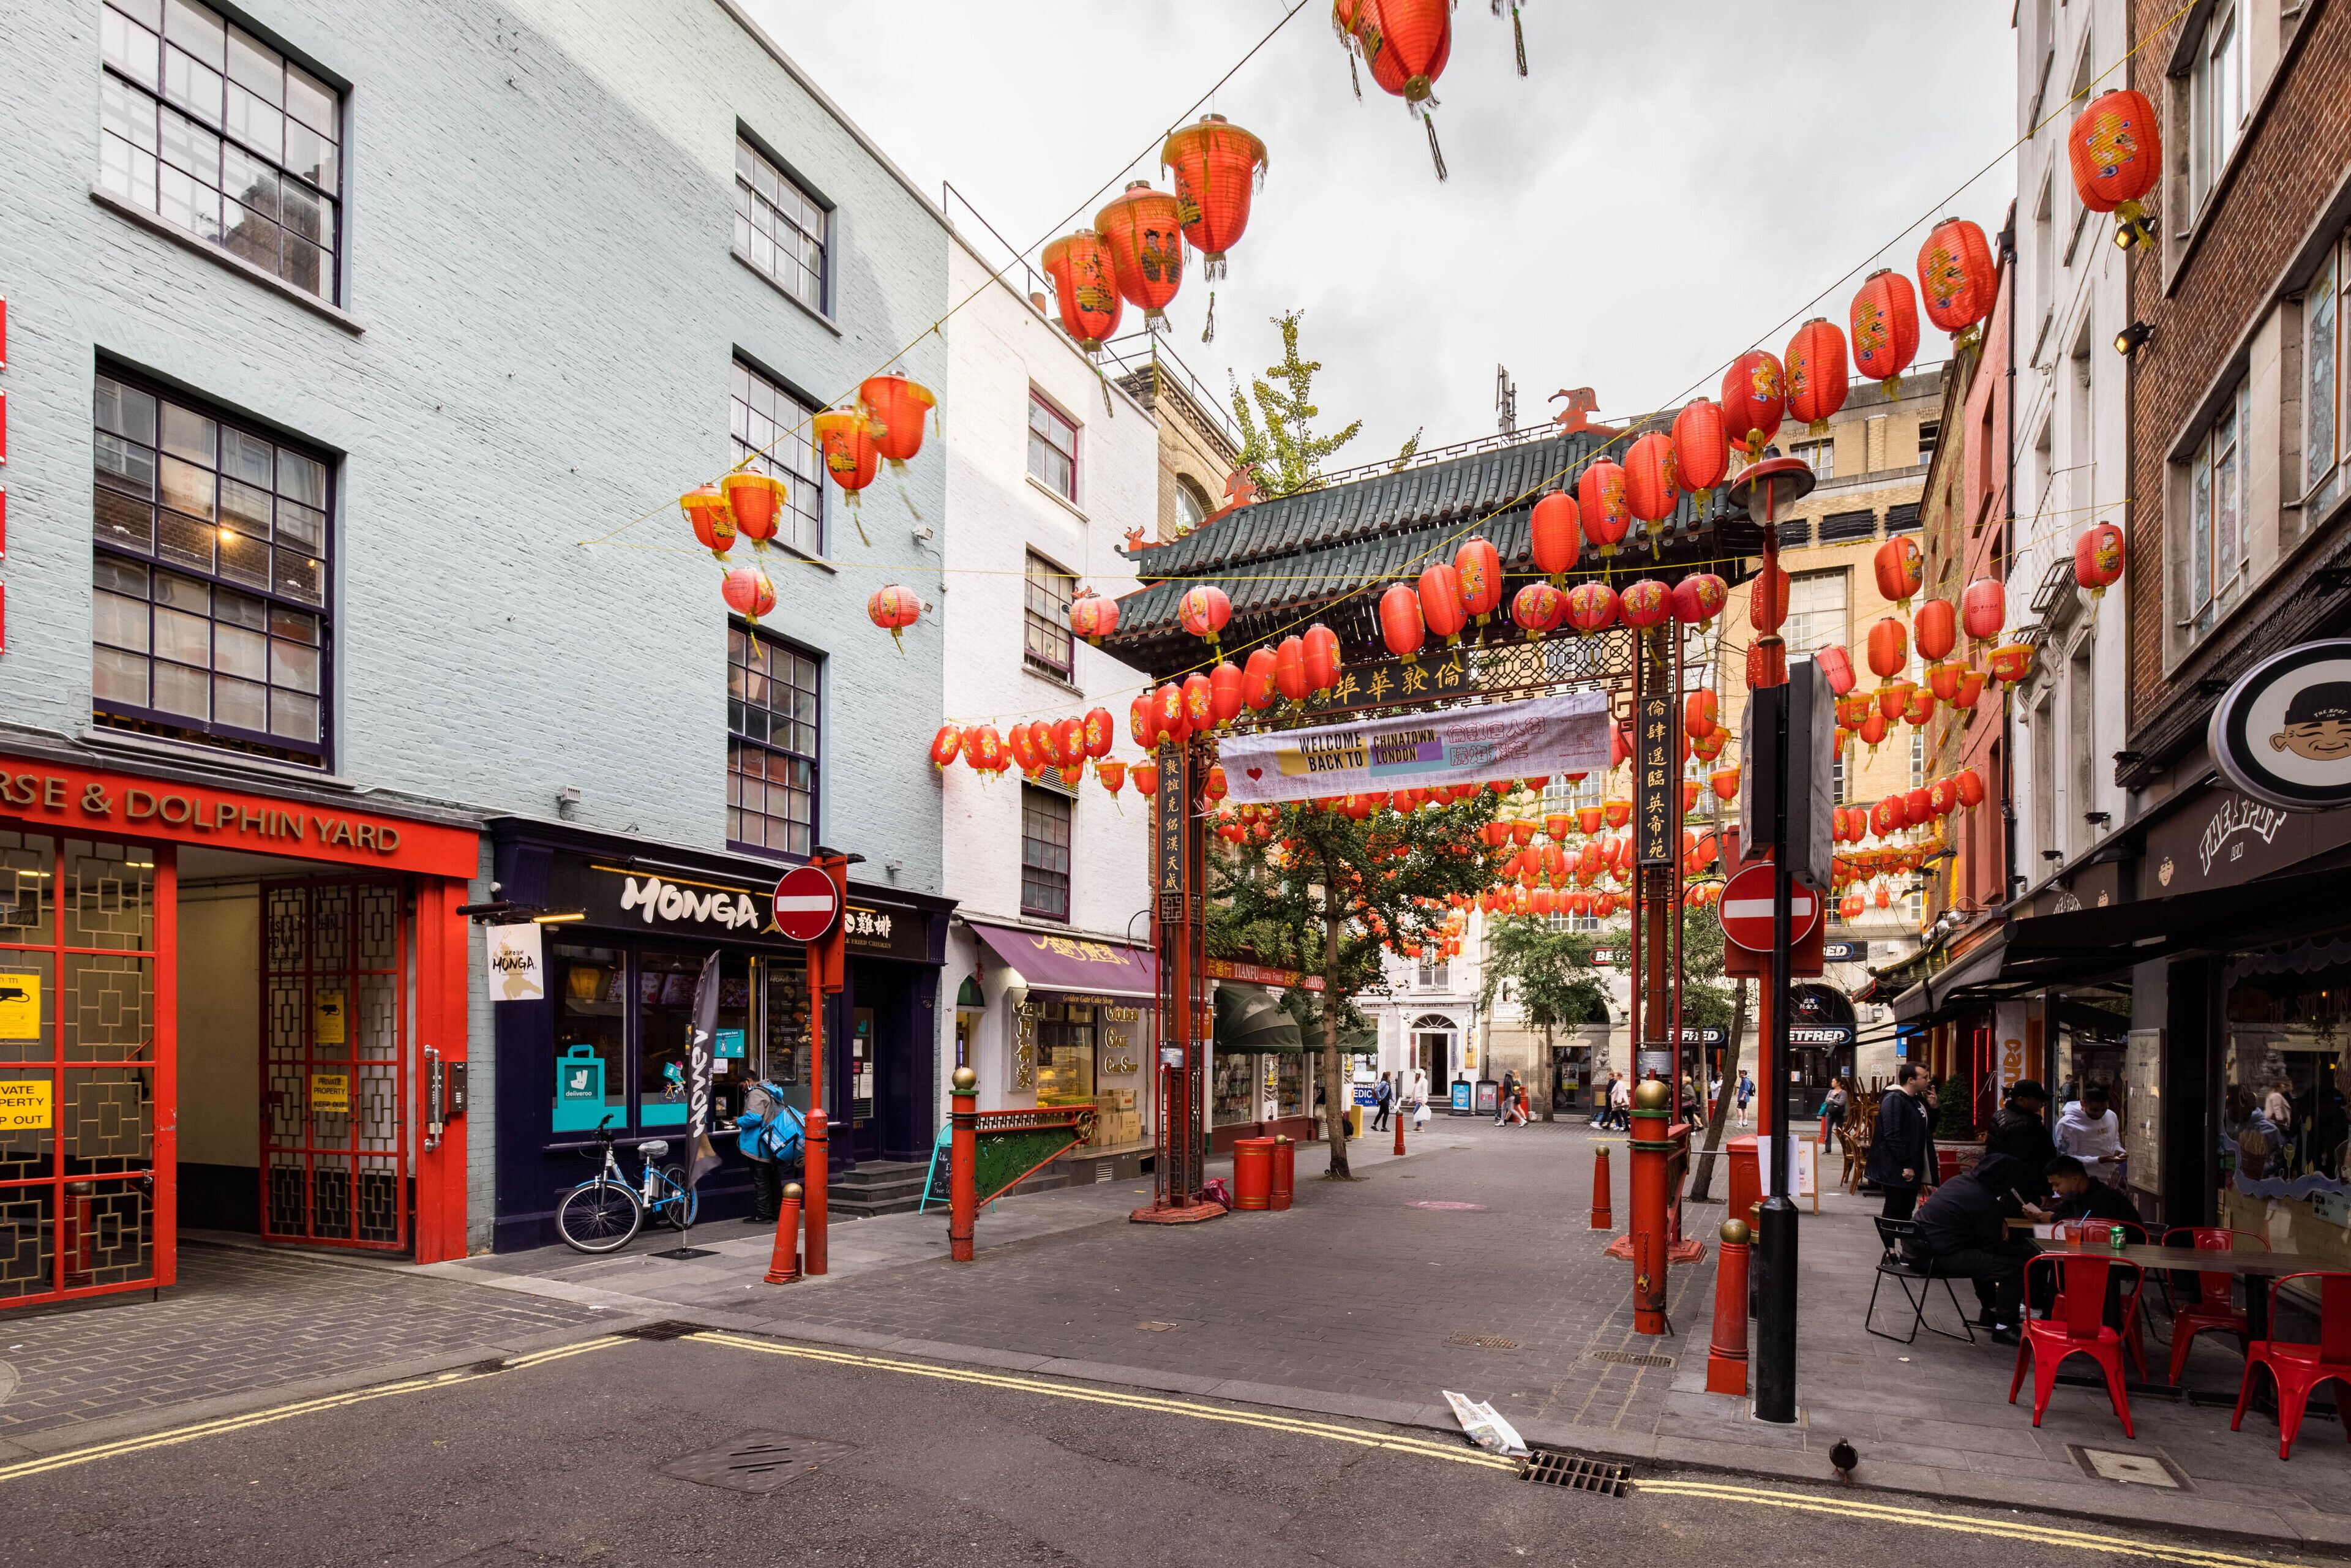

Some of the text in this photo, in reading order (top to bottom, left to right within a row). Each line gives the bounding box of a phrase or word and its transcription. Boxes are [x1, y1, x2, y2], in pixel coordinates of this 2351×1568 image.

[1373, 729, 1436, 749] CHINATOWN
[1447, 716, 1546, 743] 倫敦唐人街
[1299, 732, 1362, 755] WELCOME
[1308, 751, 1363, 772] BACK TO
[1377, 747, 1417, 765] LONDON
[1232, 778, 1309, 796] CHINATOWN
[81, 783, 113, 814] &
[126, 789, 304, 839] DOLPHIN
[313, 816, 401, 851] YARD
[2199, 800, 2231, 876] THE
[621, 877, 759, 930] MONGA
[869, 940, 892, 949] CHICKEN
[493, 956, 534, 973] MONGA
[1207, 959, 1232, 978] 天福行
[1234, 963, 1284, 982] TIANFU Lucky Foods
[1063, 994, 1079, 1002] Golden
[1102, 997, 1114, 1005] Shop
[1105, 1006, 1139, 1022] GOLDEN
[1105, 1026, 1128, 1048] GATE
[1790, 1030, 1845, 1042] ETFRED
[1, 1086, 35, 1095] VATE
[689, 1029, 708, 1138] MONGA
[1354, 1089, 1372, 1098] EDIC
[13, 1115, 44, 1125] OUT
